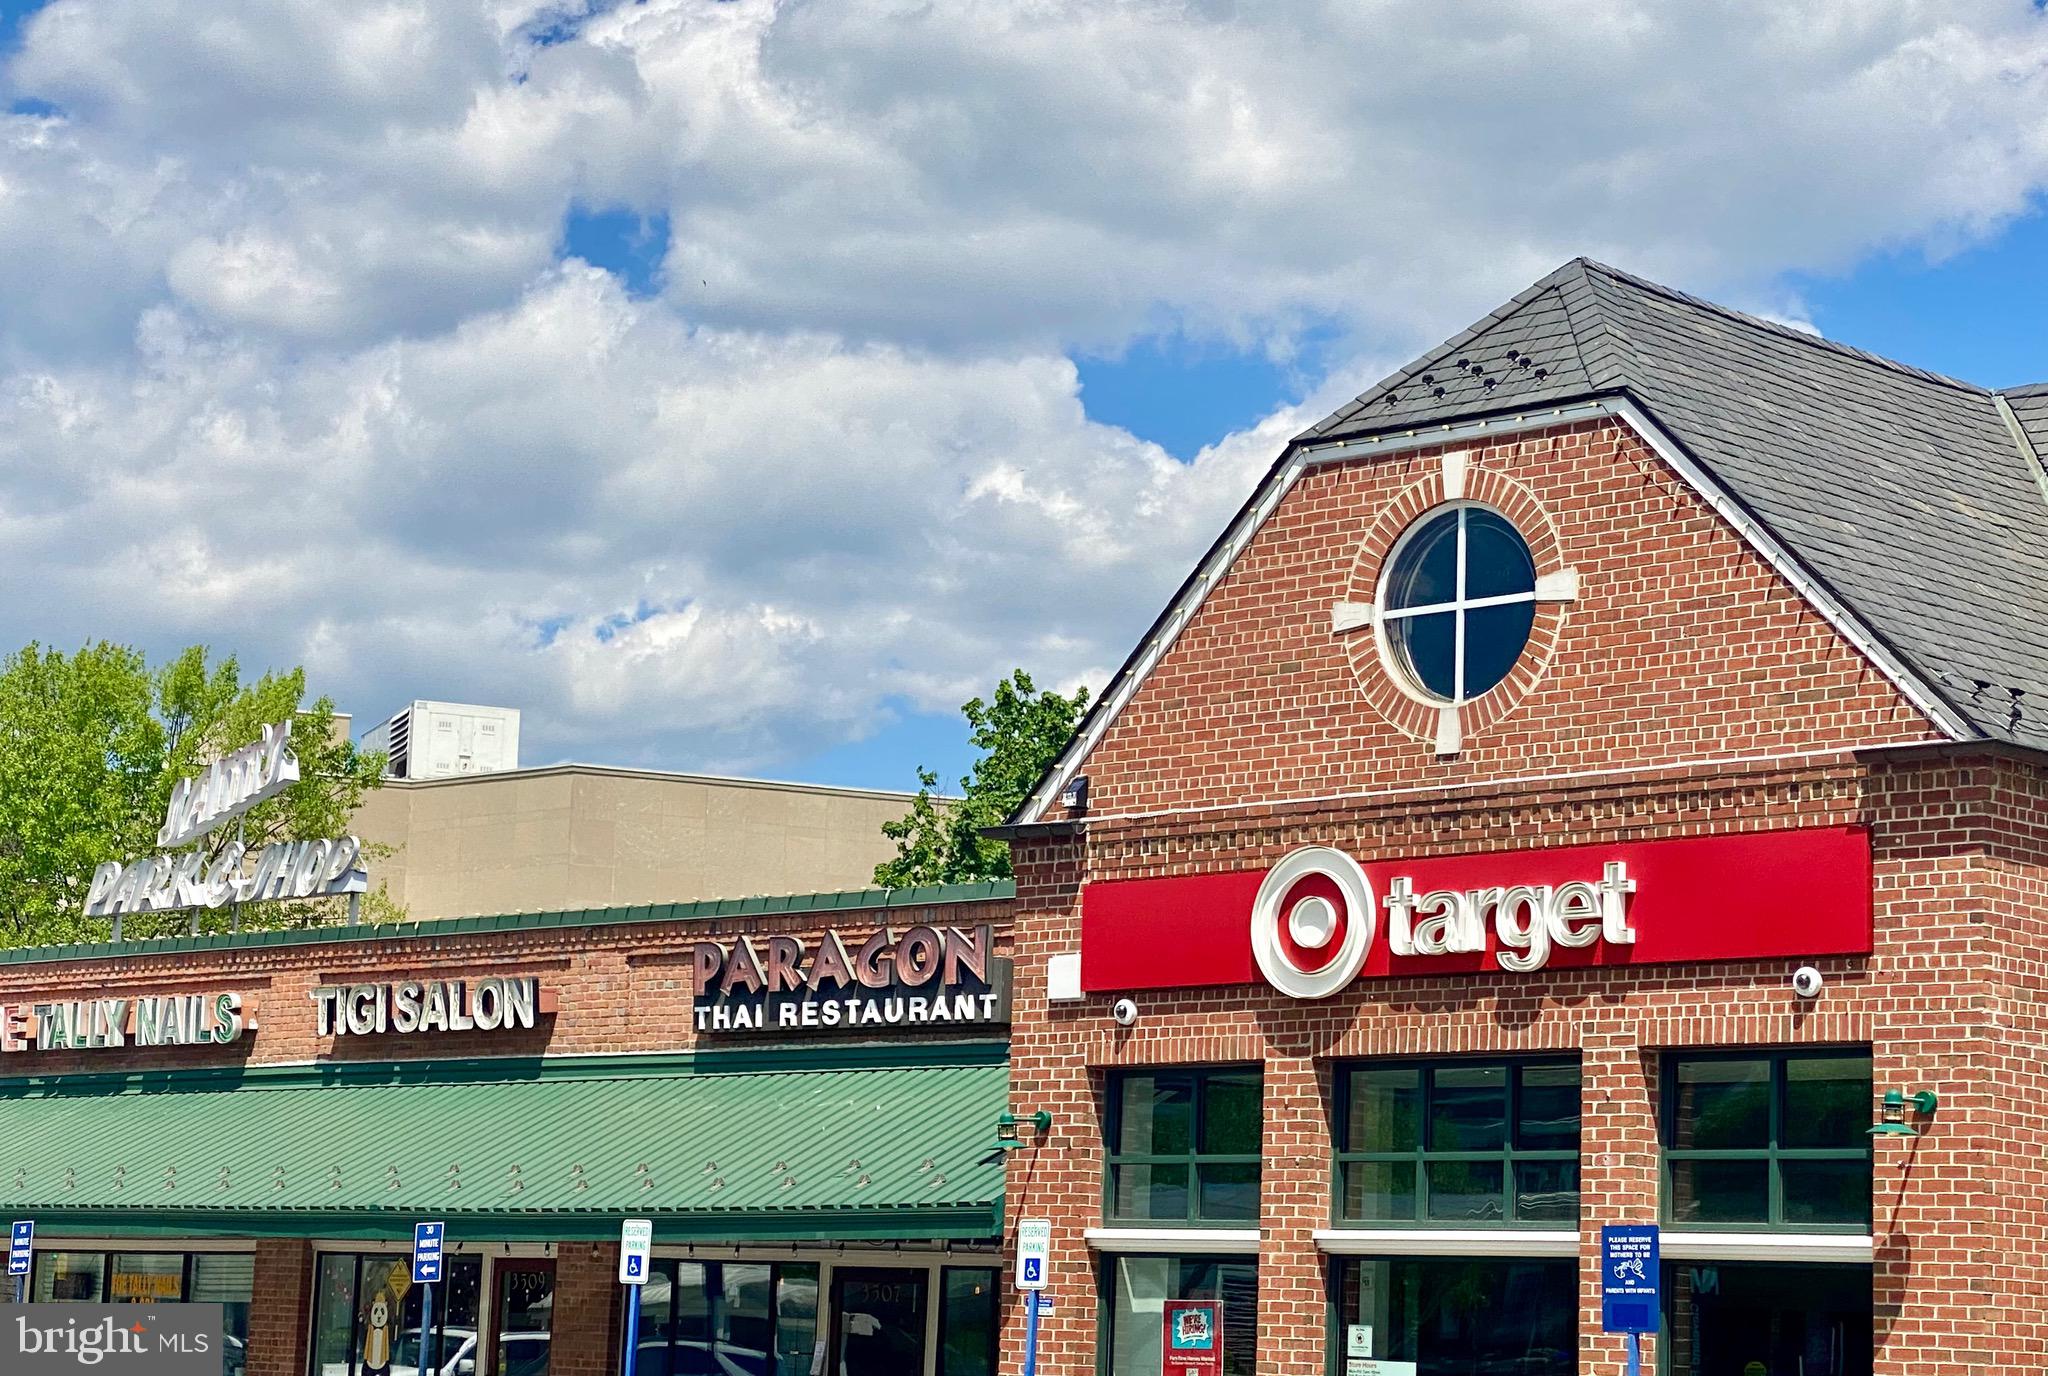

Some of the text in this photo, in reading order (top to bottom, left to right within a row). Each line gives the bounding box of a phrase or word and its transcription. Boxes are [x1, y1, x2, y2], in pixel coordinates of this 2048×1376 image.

[83, 851, 207, 916] PARK
[240, 835, 360, 902] SHOP
[1382, 861, 1637, 972] target
[694, 923, 993, 997] PARAGON
[309, 977, 536, 1036] TIGI SALON
[694, 994, 998, 1030] THAI RESTAURANT
[33, 999, 129, 1050] TALLY
[135, 993, 242, 1047] NAILS
[426, 1226, 434, 1234] 30
[624, 1226, 649, 1236] RESERVED
[1022, 1226, 1048, 1237] RESERVED
[419, 1239, 440, 1248] MINUTE
[625, 1240, 646, 1250] PARKING
[1023, 1242, 1045, 1252] PARKING
[417, 1252, 440, 1262] PARKING
[511, 1272, 545, 1290] 3509
[1605, 1286, 1656, 1295] PARENTS WITH INFANTS
